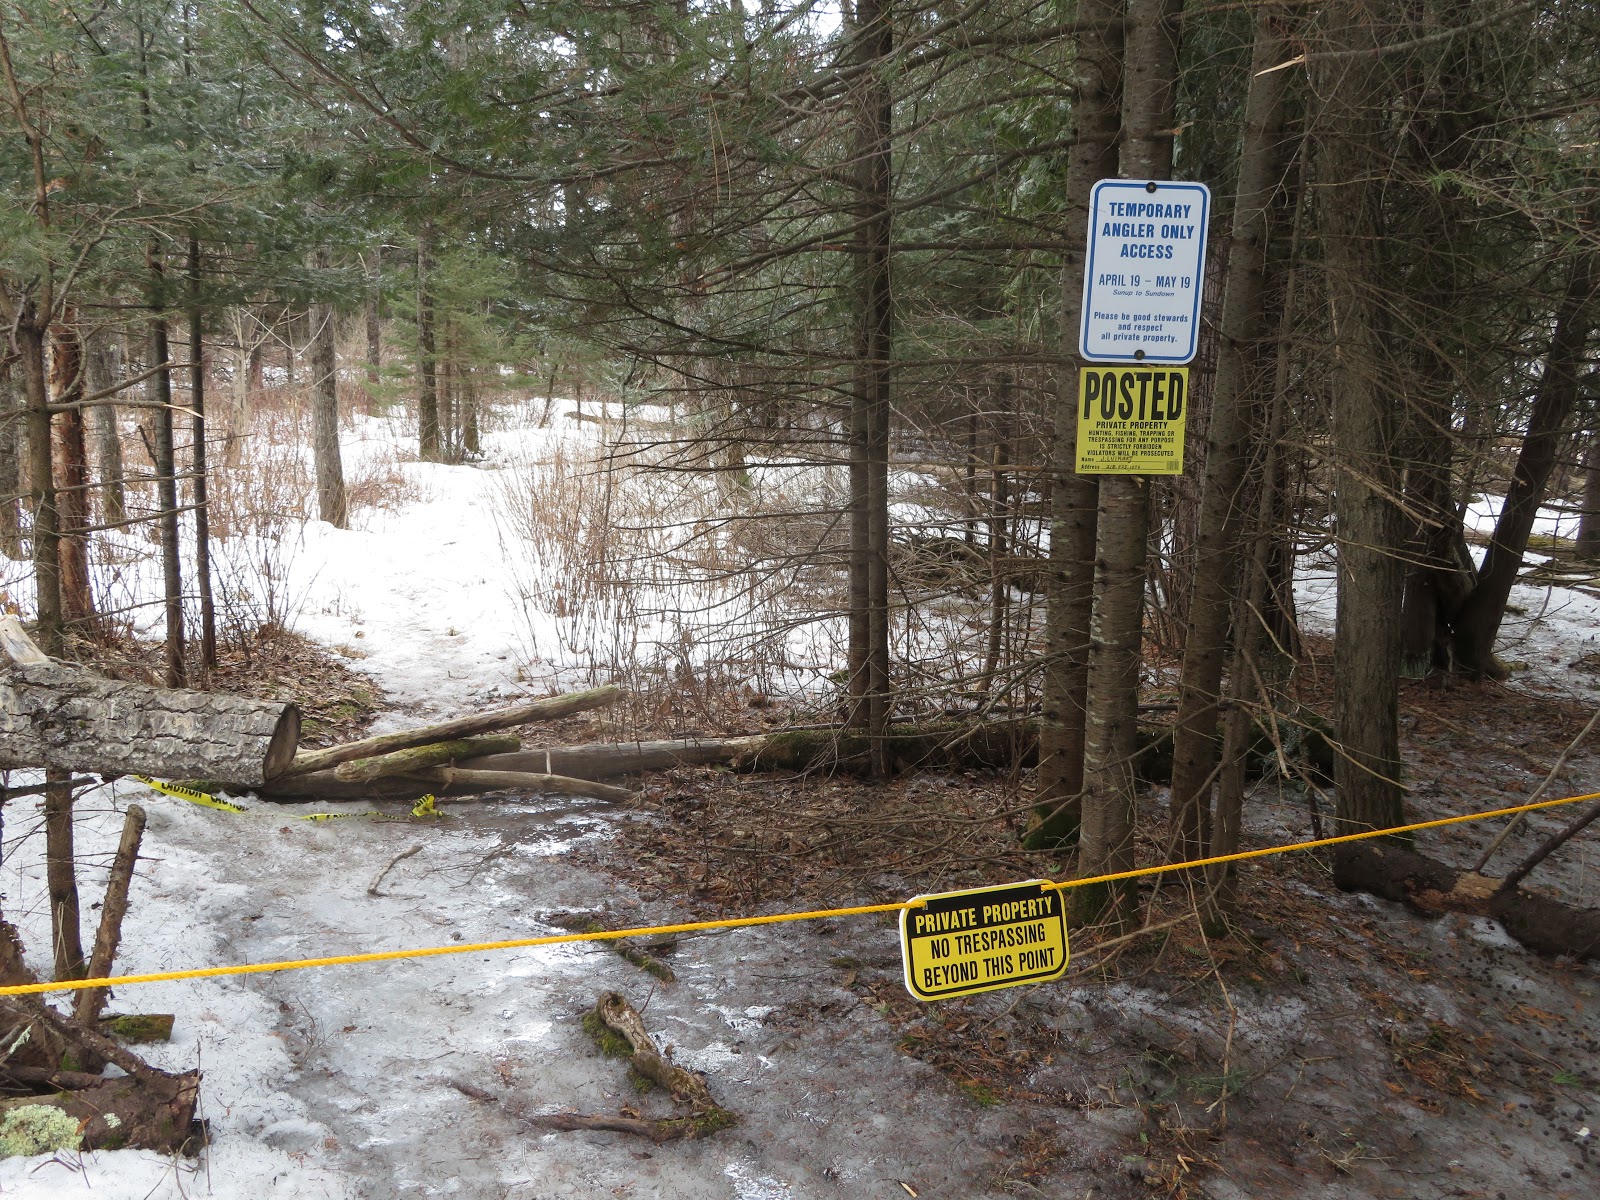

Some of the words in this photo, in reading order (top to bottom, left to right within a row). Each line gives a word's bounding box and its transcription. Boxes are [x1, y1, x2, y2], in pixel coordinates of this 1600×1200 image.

[1109, 202, 1191, 218] TEMPORARY
[1102, 222, 1154, 238] ANGLER
[1161, 224, 1194, 239] ONLY
[1120, 243, 1173, 259] ACCESS
[1099, 274, 1126, 287] APRIL
[1130, 275, 1141, 287] 19
[1155, 276, 1177, 288] MAY
[1180, 276, 1191, 289] 19
[1094, 312, 1118, 320] Please
[1121, 312, 1130, 320] be
[1133, 313, 1151, 322] good
[1154, 314, 1188, 322] stewards
[1118, 323, 1131, 331] and
[1134, 324, 1162, 332] respect
[1101, 332, 1110, 340] all
[1113, 333, 1140, 341] private
[1143, 334, 1178, 343] property.
[1084, 372, 1184, 420] POSTED
[1096, 421, 1126, 429] PRIVATE
[1130, 421, 1168, 429] PROPERTY
[915, 908, 977, 934] PRIVATE
[983, 896, 1053, 924] PROPERTY
[930, 938, 950, 959] NO
[955, 923, 1046, 955] TRESPASSING
[924, 960, 978, 988] BEYOND
[983, 955, 1013, 977] THIS
[1018, 947, 1055, 971] POINT
